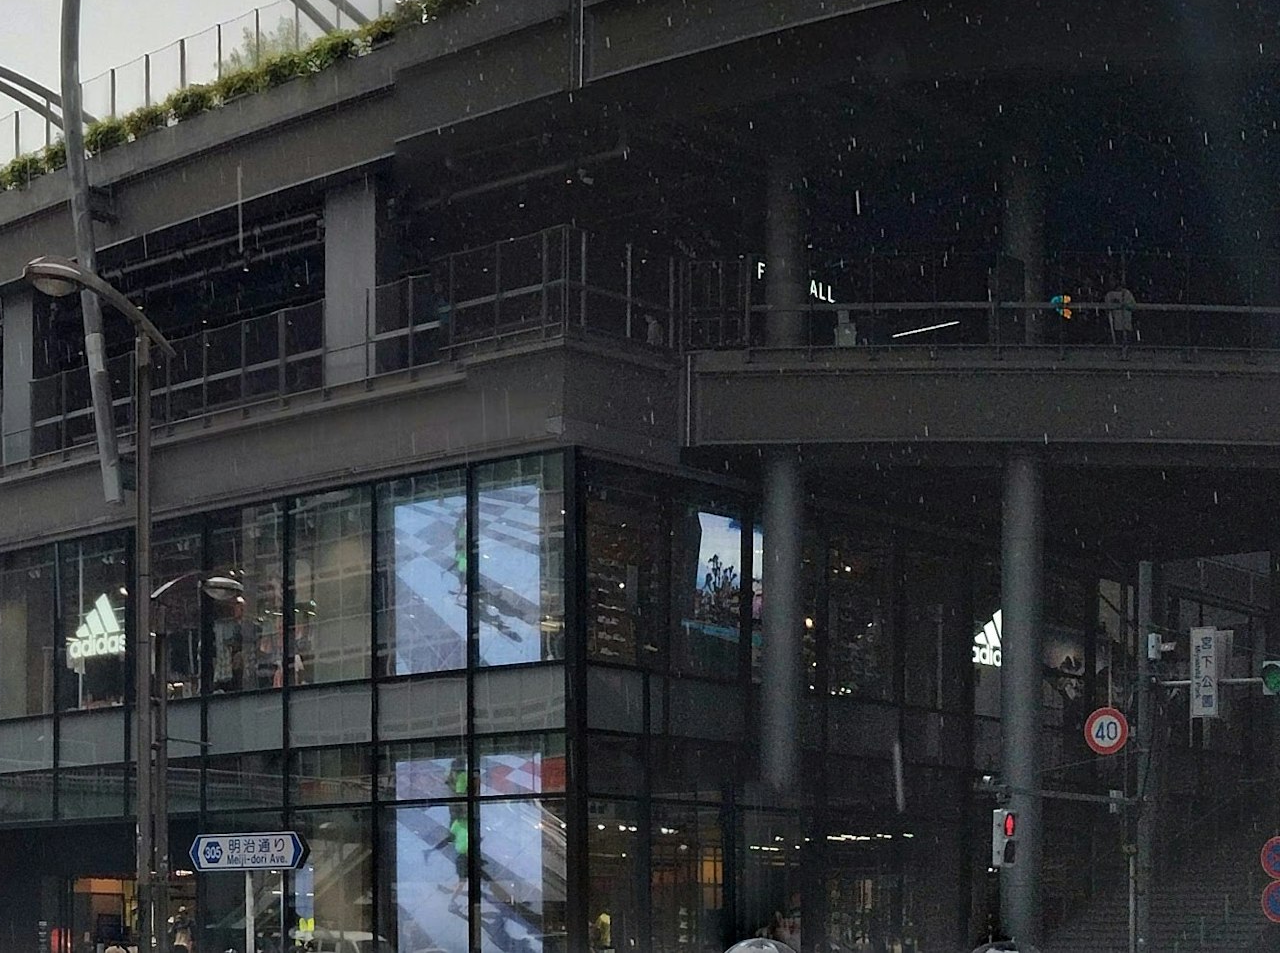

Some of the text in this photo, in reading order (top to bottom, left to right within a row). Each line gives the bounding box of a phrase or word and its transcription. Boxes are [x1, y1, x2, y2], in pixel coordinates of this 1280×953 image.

[70, 633, 126, 658] adidas
[1095, 721, 1118, 741] 40
[205, 846, 221, 859] 305
[228, 838, 286, 854] 明治通り
[227, 853, 288, 867] Meiji-dori Ave.
